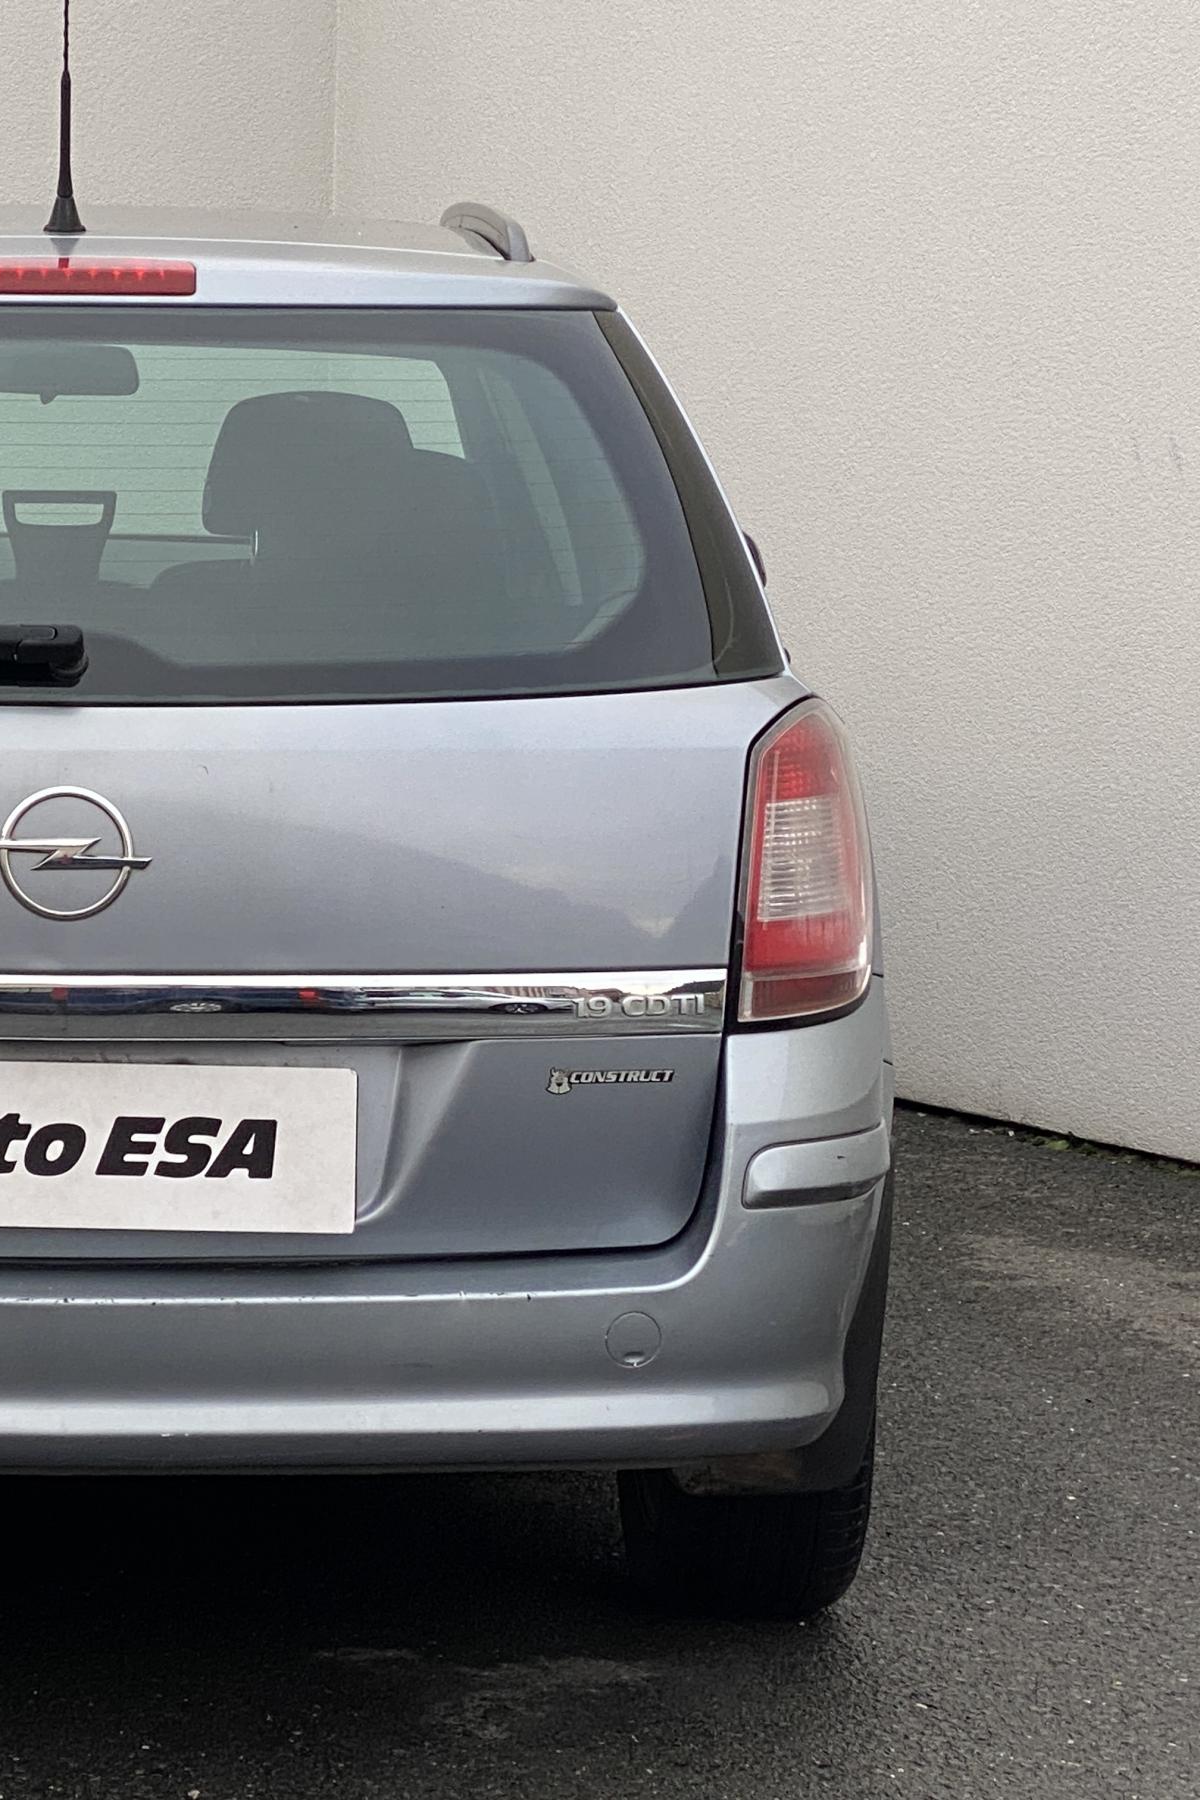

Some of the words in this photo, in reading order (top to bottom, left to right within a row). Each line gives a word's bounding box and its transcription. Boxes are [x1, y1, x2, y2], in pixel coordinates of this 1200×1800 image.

[621, 993, 705, 1017] CDTI
[569, 1069, 675, 1084] CONSTRUCT
[95, 1116, 278, 1179] ESA
